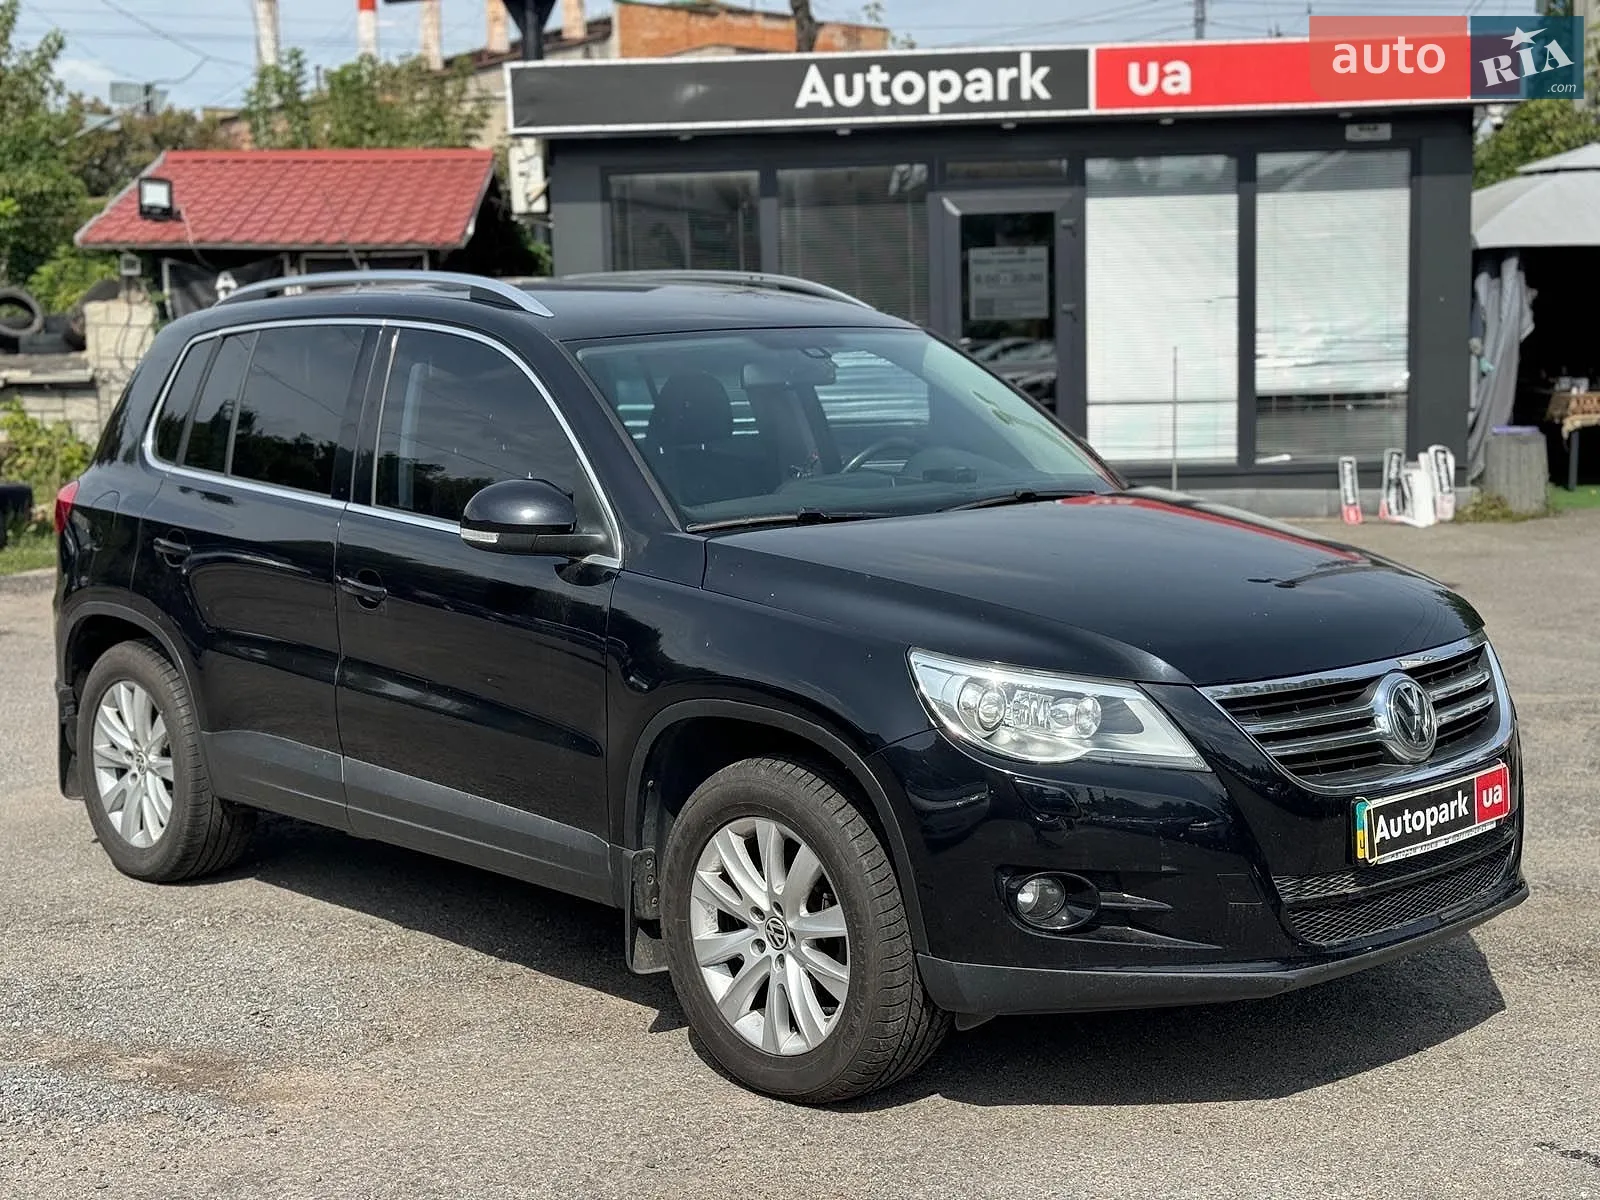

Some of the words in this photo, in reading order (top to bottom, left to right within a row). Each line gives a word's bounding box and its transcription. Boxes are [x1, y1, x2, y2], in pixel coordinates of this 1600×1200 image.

[795, 52, 1051, 113] Autopark
[1127, 60, 1192, 97] ua
[1375, 790, 1469, 843] Autopark
[1482, 784, 1503, 808] ua
